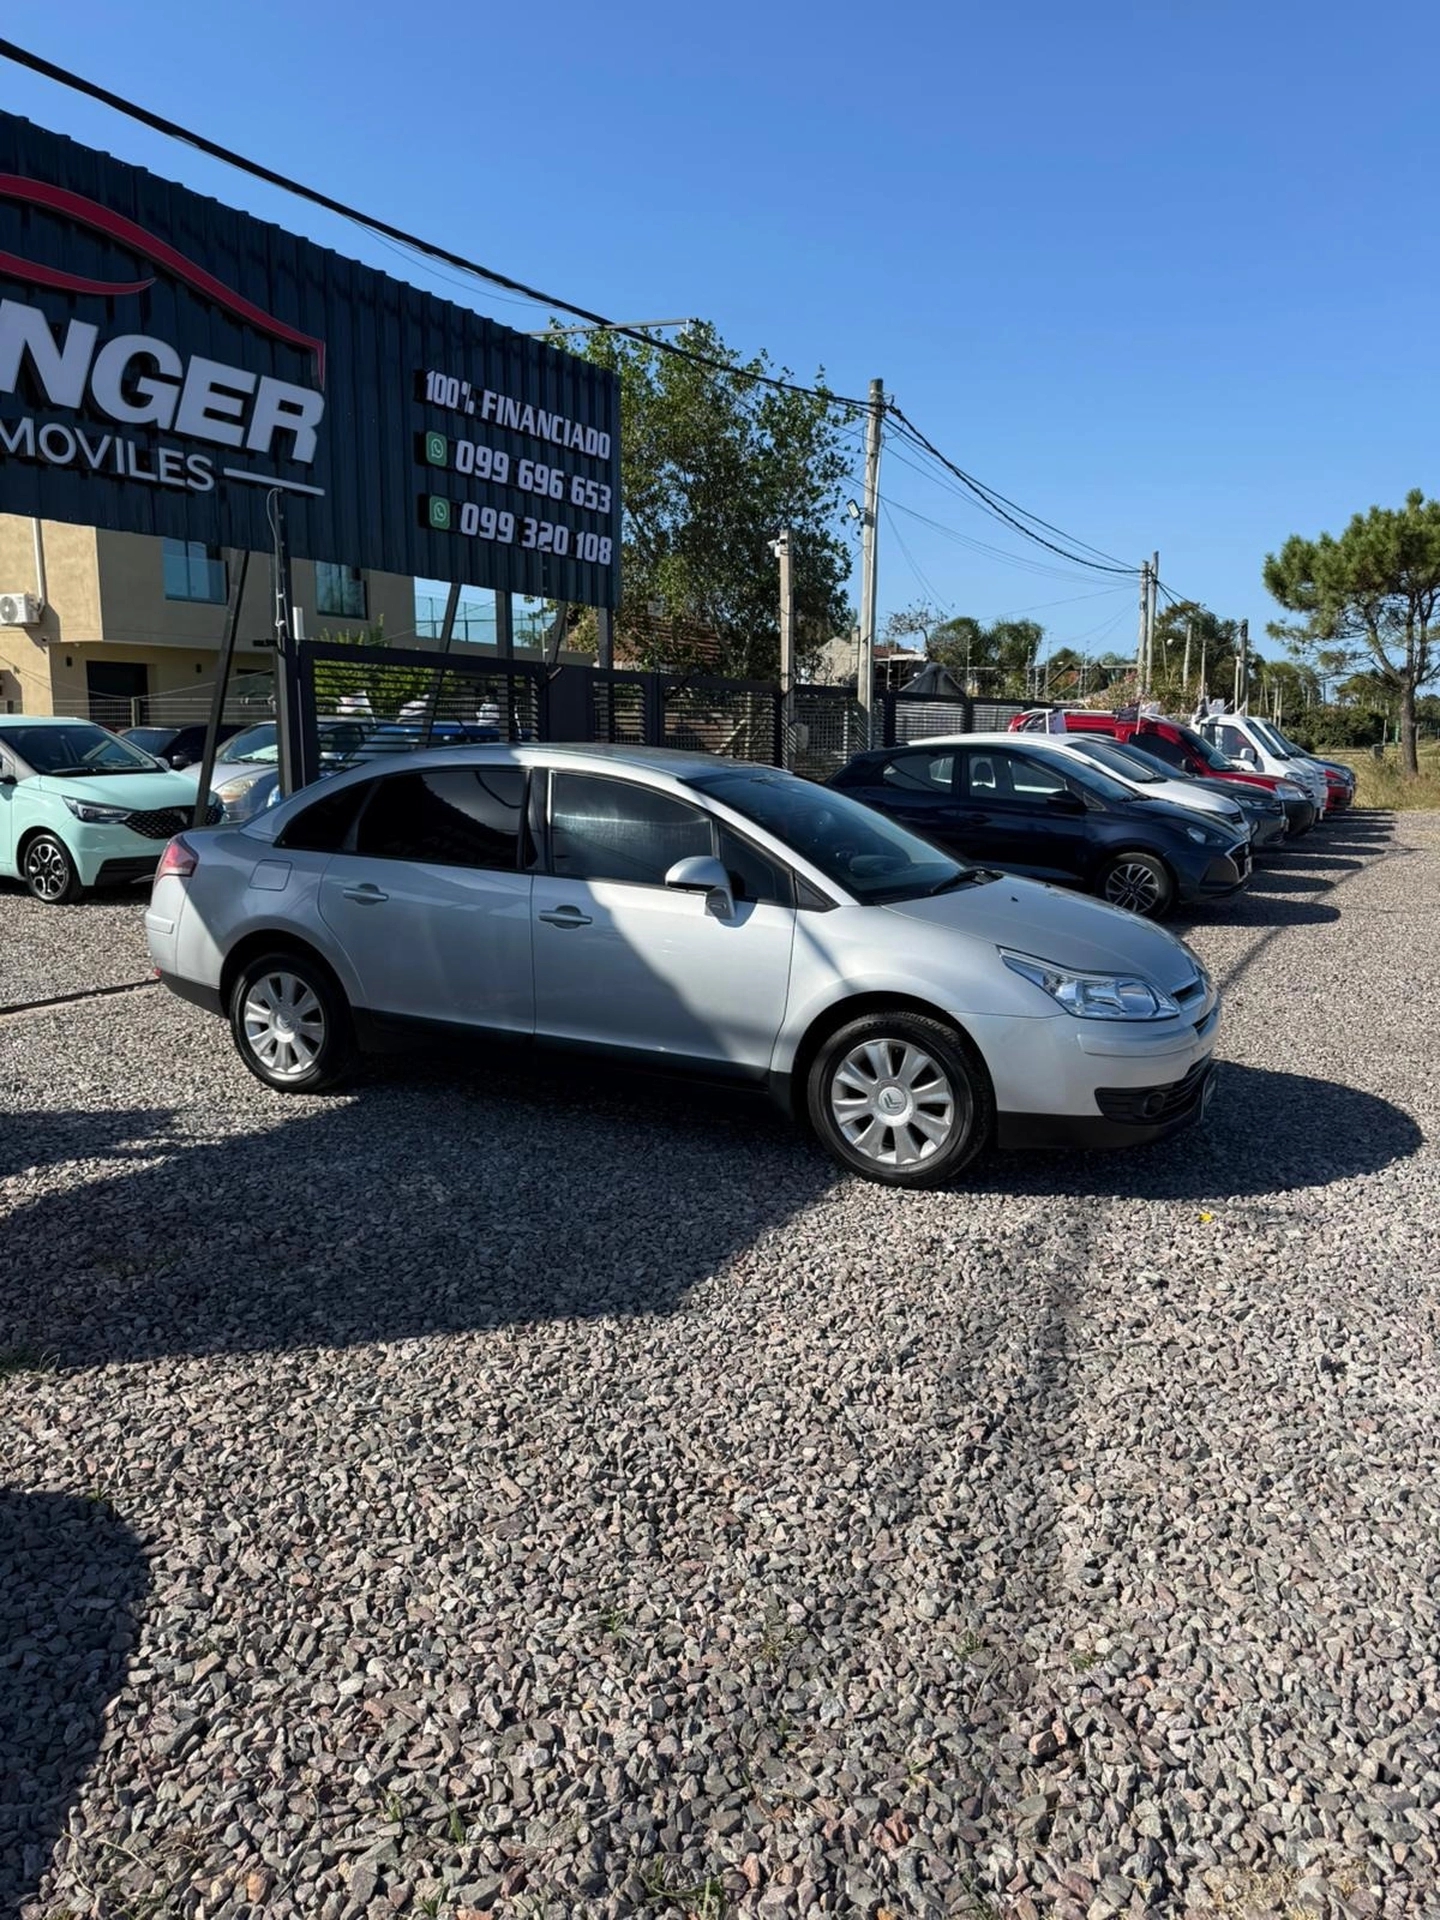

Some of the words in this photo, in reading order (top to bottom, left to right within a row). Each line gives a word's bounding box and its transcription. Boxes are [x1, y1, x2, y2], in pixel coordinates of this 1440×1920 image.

[0, 298, 325, 463] NGER
[426, 370, 474, 415] 100%
[481, 389, 610, 460] FINANCIADO
[455, 439, 509, 484] 099
[517, 458, 564, 500] 696
[570, 475, 611, 514] 653
[460, 502, 514, 544] 099
[521, 516, 569, 556] 320
[576, 531, 612, 565] 108
